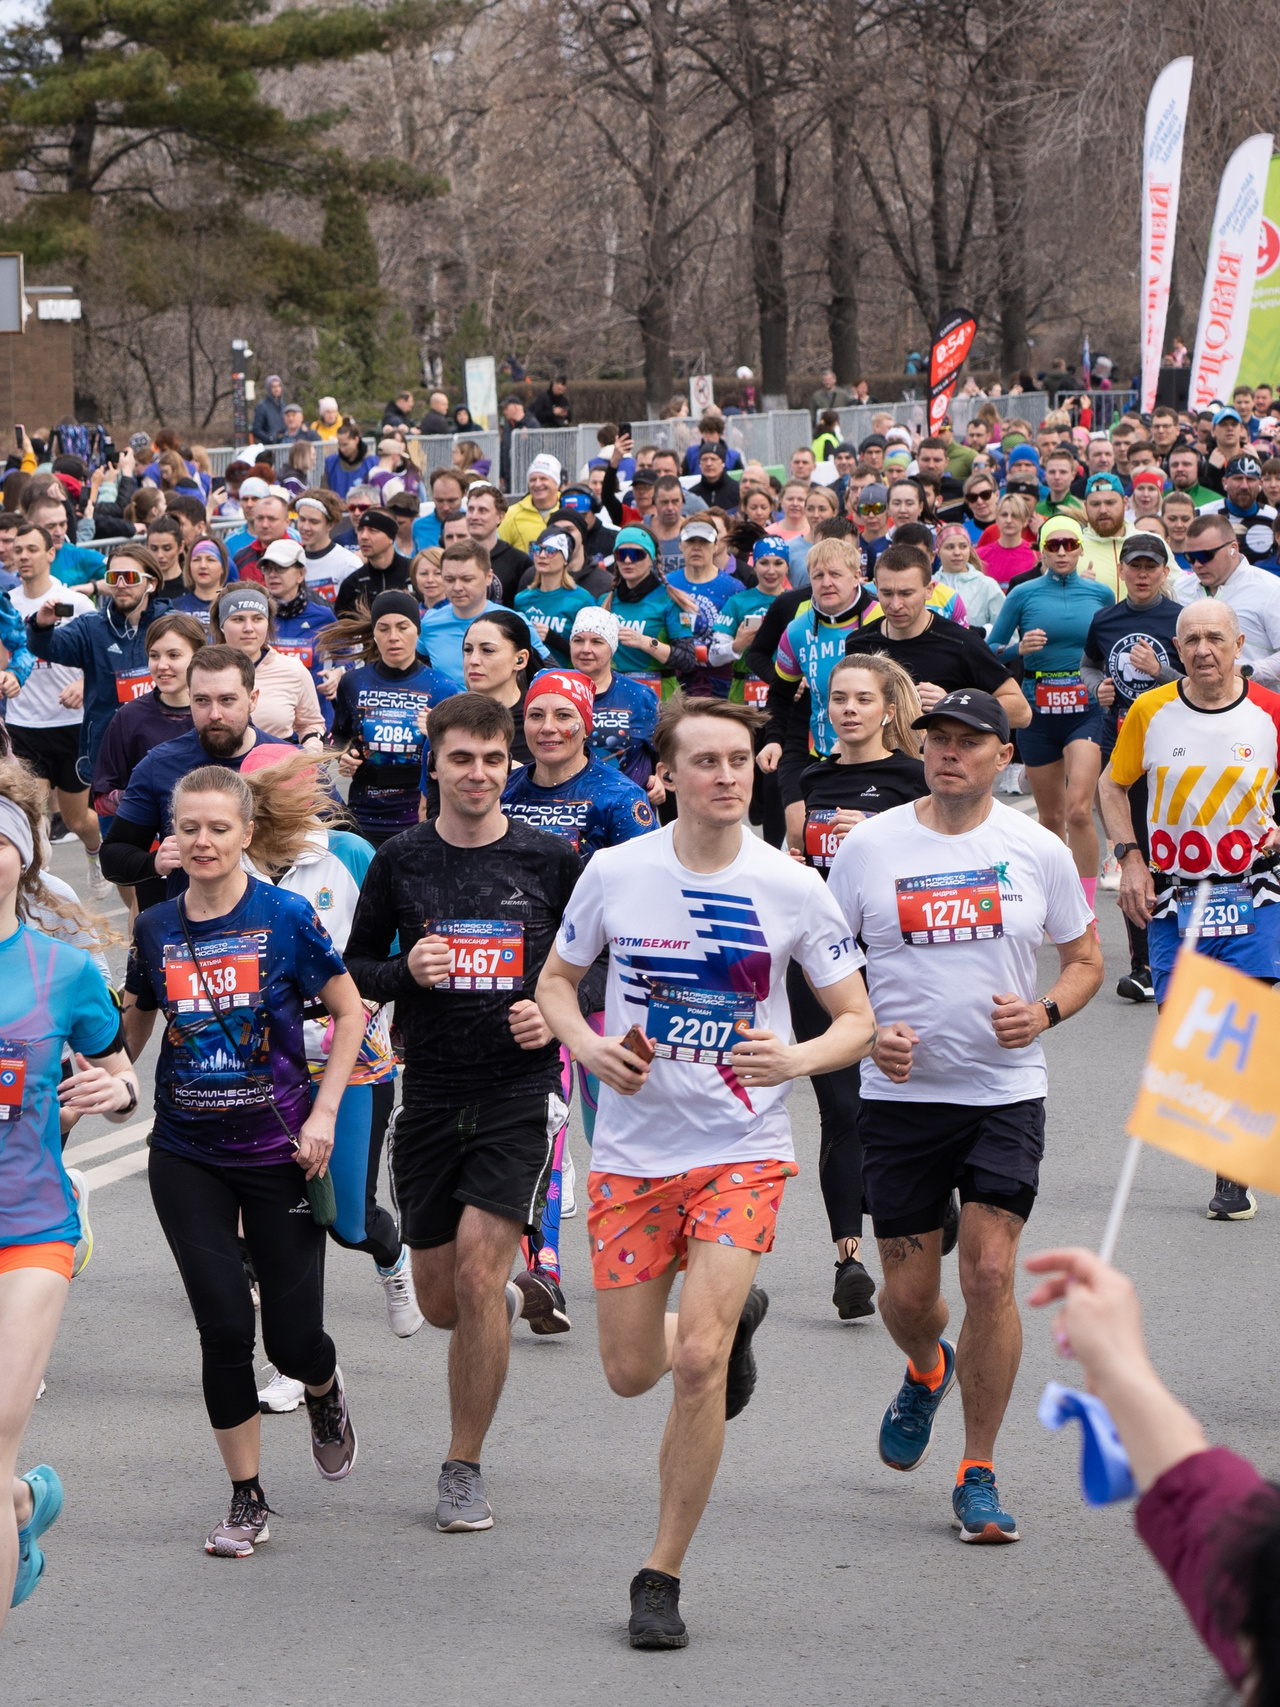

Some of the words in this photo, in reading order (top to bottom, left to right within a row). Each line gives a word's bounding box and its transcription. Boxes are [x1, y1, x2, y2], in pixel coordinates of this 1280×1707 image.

[799, 639, 846, 663] SAMA
[755, 686, 770, 699] 17
[1046, 691, 1077, 706] 1563
[593, 719, 629, 729] МОС
[374, 725, 414, 743] 2084
[508, 814, 587, 827] ОСМОС
[820, 833, 838, 854] 18
[931, 889, 958, 898] АНДРЕЙ
[921, 898, 978, 927] 1274
[613, 936, 691, 950] #ЭТМБЕЖИТ
[199, 959, 222, 967] ТАТЬЯНА
[448, 948, 501, 974] 1467
[188, 966, 237, 996] 1438
[687, 1007, 712, 1016] РОМАН
[667, 1015, 734, 1048] 2207
